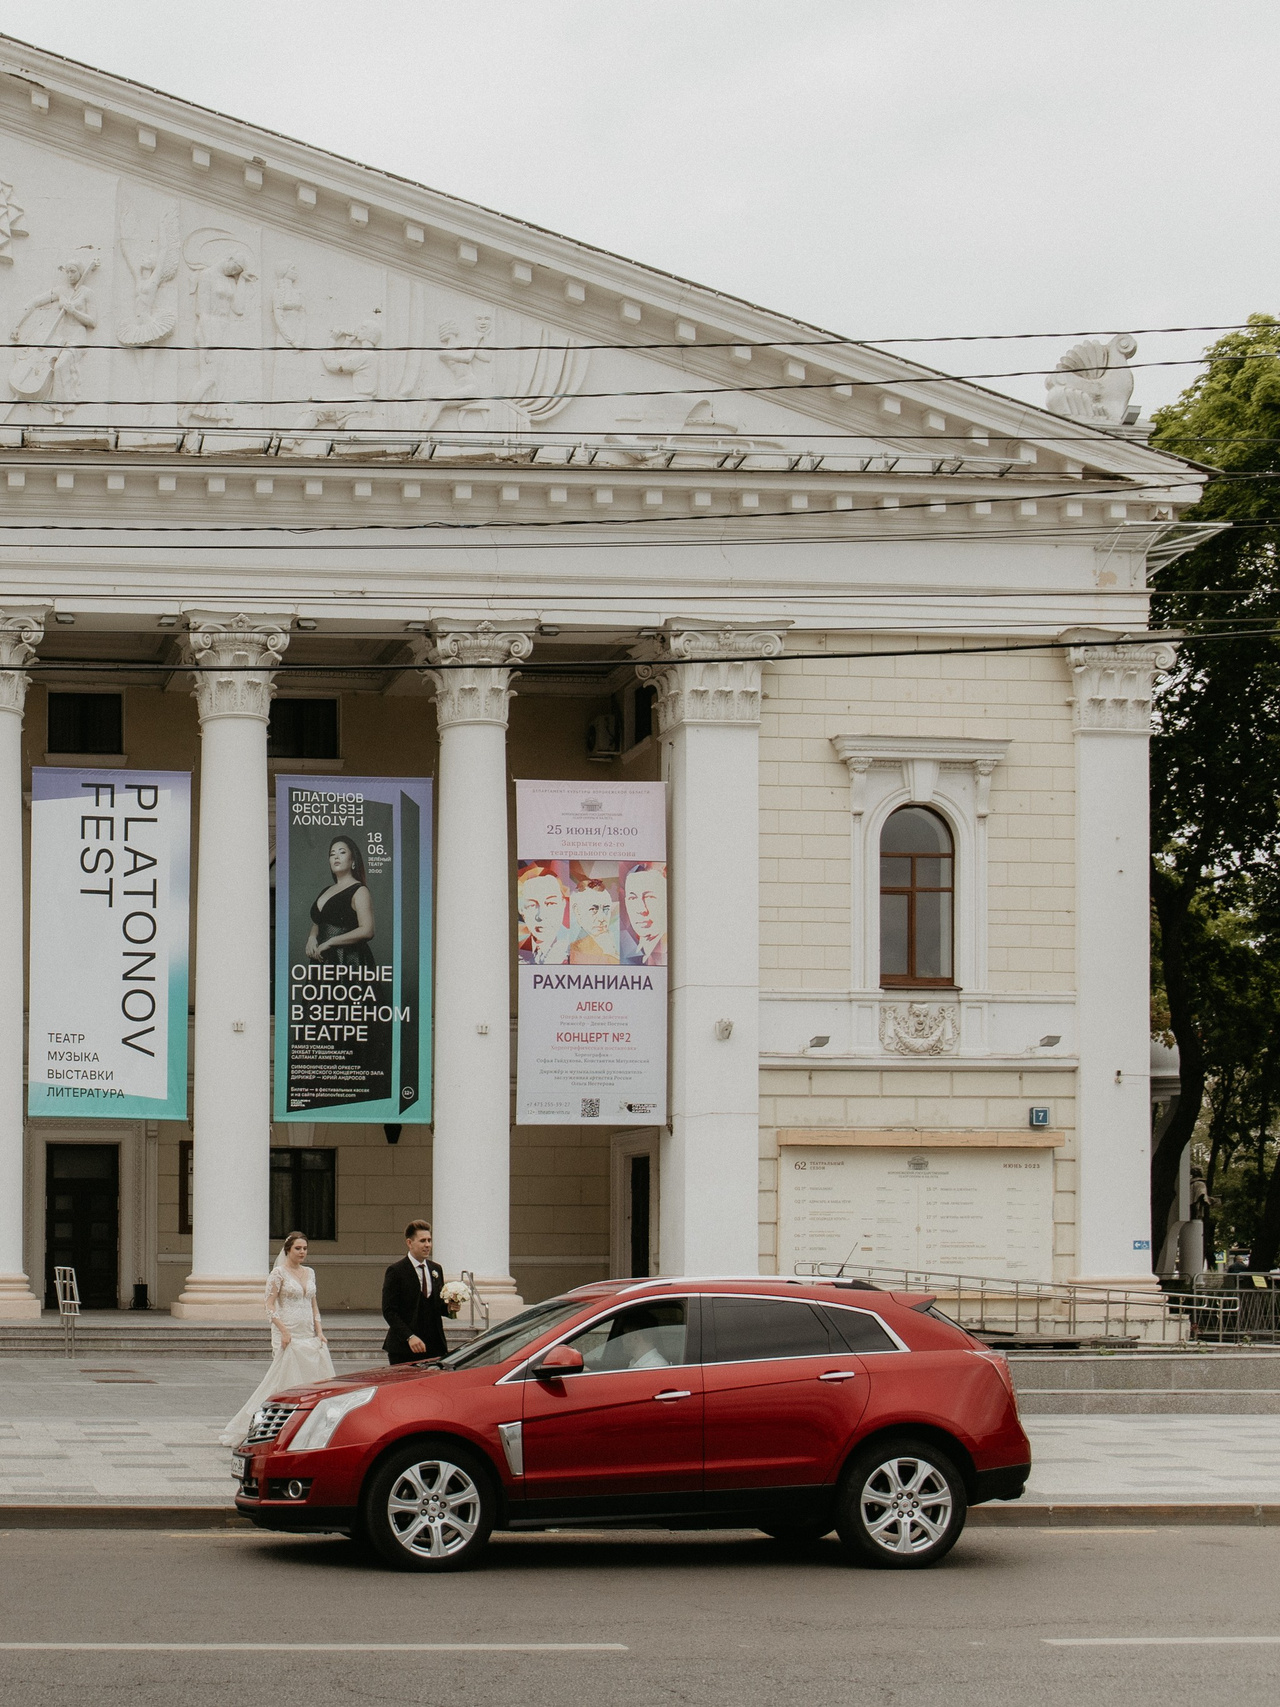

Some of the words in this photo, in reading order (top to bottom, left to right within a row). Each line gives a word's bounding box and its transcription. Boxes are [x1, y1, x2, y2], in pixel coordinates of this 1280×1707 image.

[292, 791, 364, 803] ПЛАТОНОВ
[292, 803, 329, 814] ФЕСТ
[330, 804, 364, 815] FEST
[292, 815, 364, 827] PLATONOV
[546, 824, 562, 835] 25
[566, 825, 638, 837] июня/18:00
[367, 832, 382, 843] 18
[80, 782, 116, 908] FEST
[367, 844, 388, 855] 06.
[562, 840, 602, 848] Закрытие
[550, 850, 607, 858] театрального
[121, 783, 159, 1058] PLATONOV
[291, 964, 393, 982] ОПЕРНЫЕ
[533, 974, 654, 990] РАХМАНИАНА
[292, 984, 376, 1002] ГОЛОСА
[292, 1004, 304, 1021] В
[309, 1002, 410, 1022] ЗЕЛЁНОМ
[576, 1001, 614, 1012] АЛЕКО
[47, 1032, 86, 1044] ТЕАТР
[290, 1024, 368, 1042] ТЕАТРЕ
[556, 1032, 609, 1044] КОНЦЕРТ
[47, 1050, 100, 1063] МУЗЫКА
[47, 1068, 114, 1081] ВЫСТАВКИ
[46, 1086, 125, 1100] ЛИТЕРАТУРА
[1038, 1112, 1044, 1120] 7
[794, 1161, 806, 1170] 62
